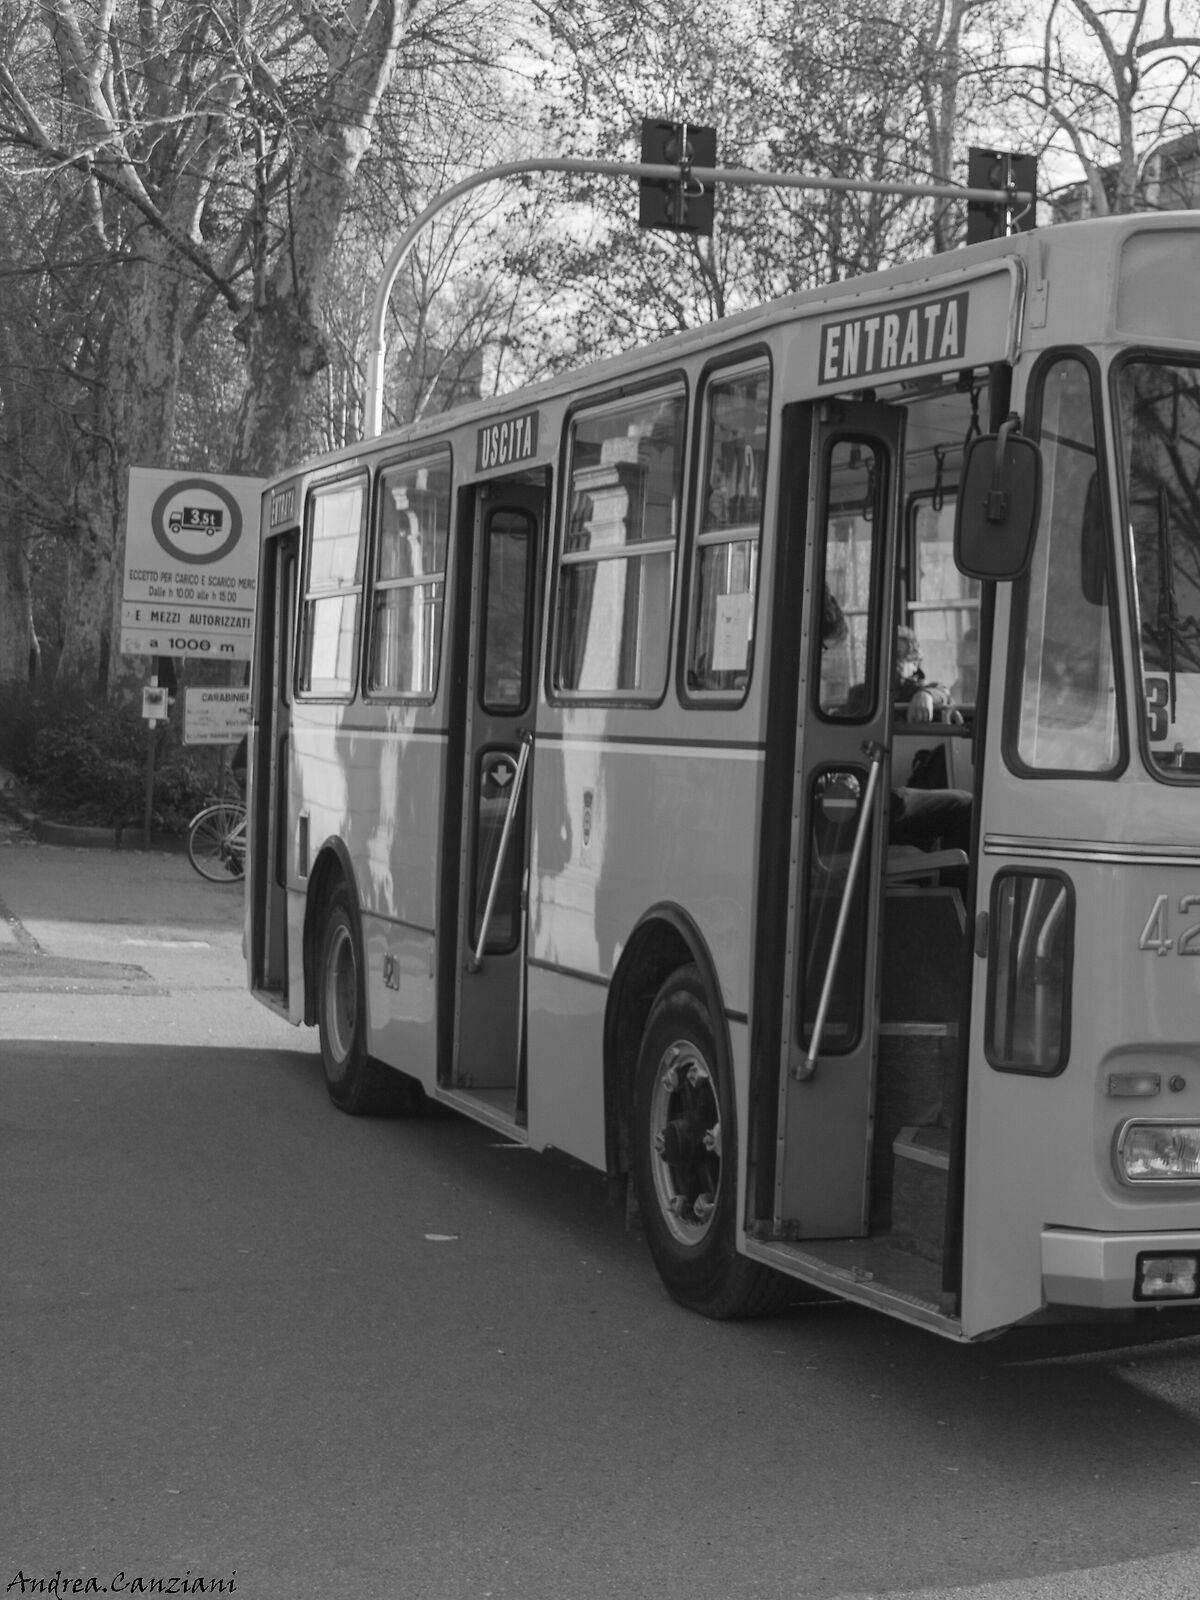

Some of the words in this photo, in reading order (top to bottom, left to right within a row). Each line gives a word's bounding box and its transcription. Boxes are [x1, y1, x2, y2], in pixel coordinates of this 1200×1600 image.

[823, 299, 959, 381] ENTRATA
[481, 415, 533, 469] USCITA
[129, 569, 159, 582] ECCETTO
[160, 571, 172, 584] PER
[175, 573, 199, 586] CARICO
[201, 575, 205, 586] E
[208, 576, 236, 588] SCARICO
[149, 586, 165, 597] Dalle
[169, 588, 173, 597] h
[197, 590, 209, 601] alle
[136, 610, 141, 620] E
[151, 611, 180, 623] MEZZI
[189, 614, 250, 628] AUTORIZZATI
[150, 640, 158, 648] a
[169, 638, 211, 651] 1000
[220, 643, 235, 653] m
[1145, 677, 1169, 742] 3
